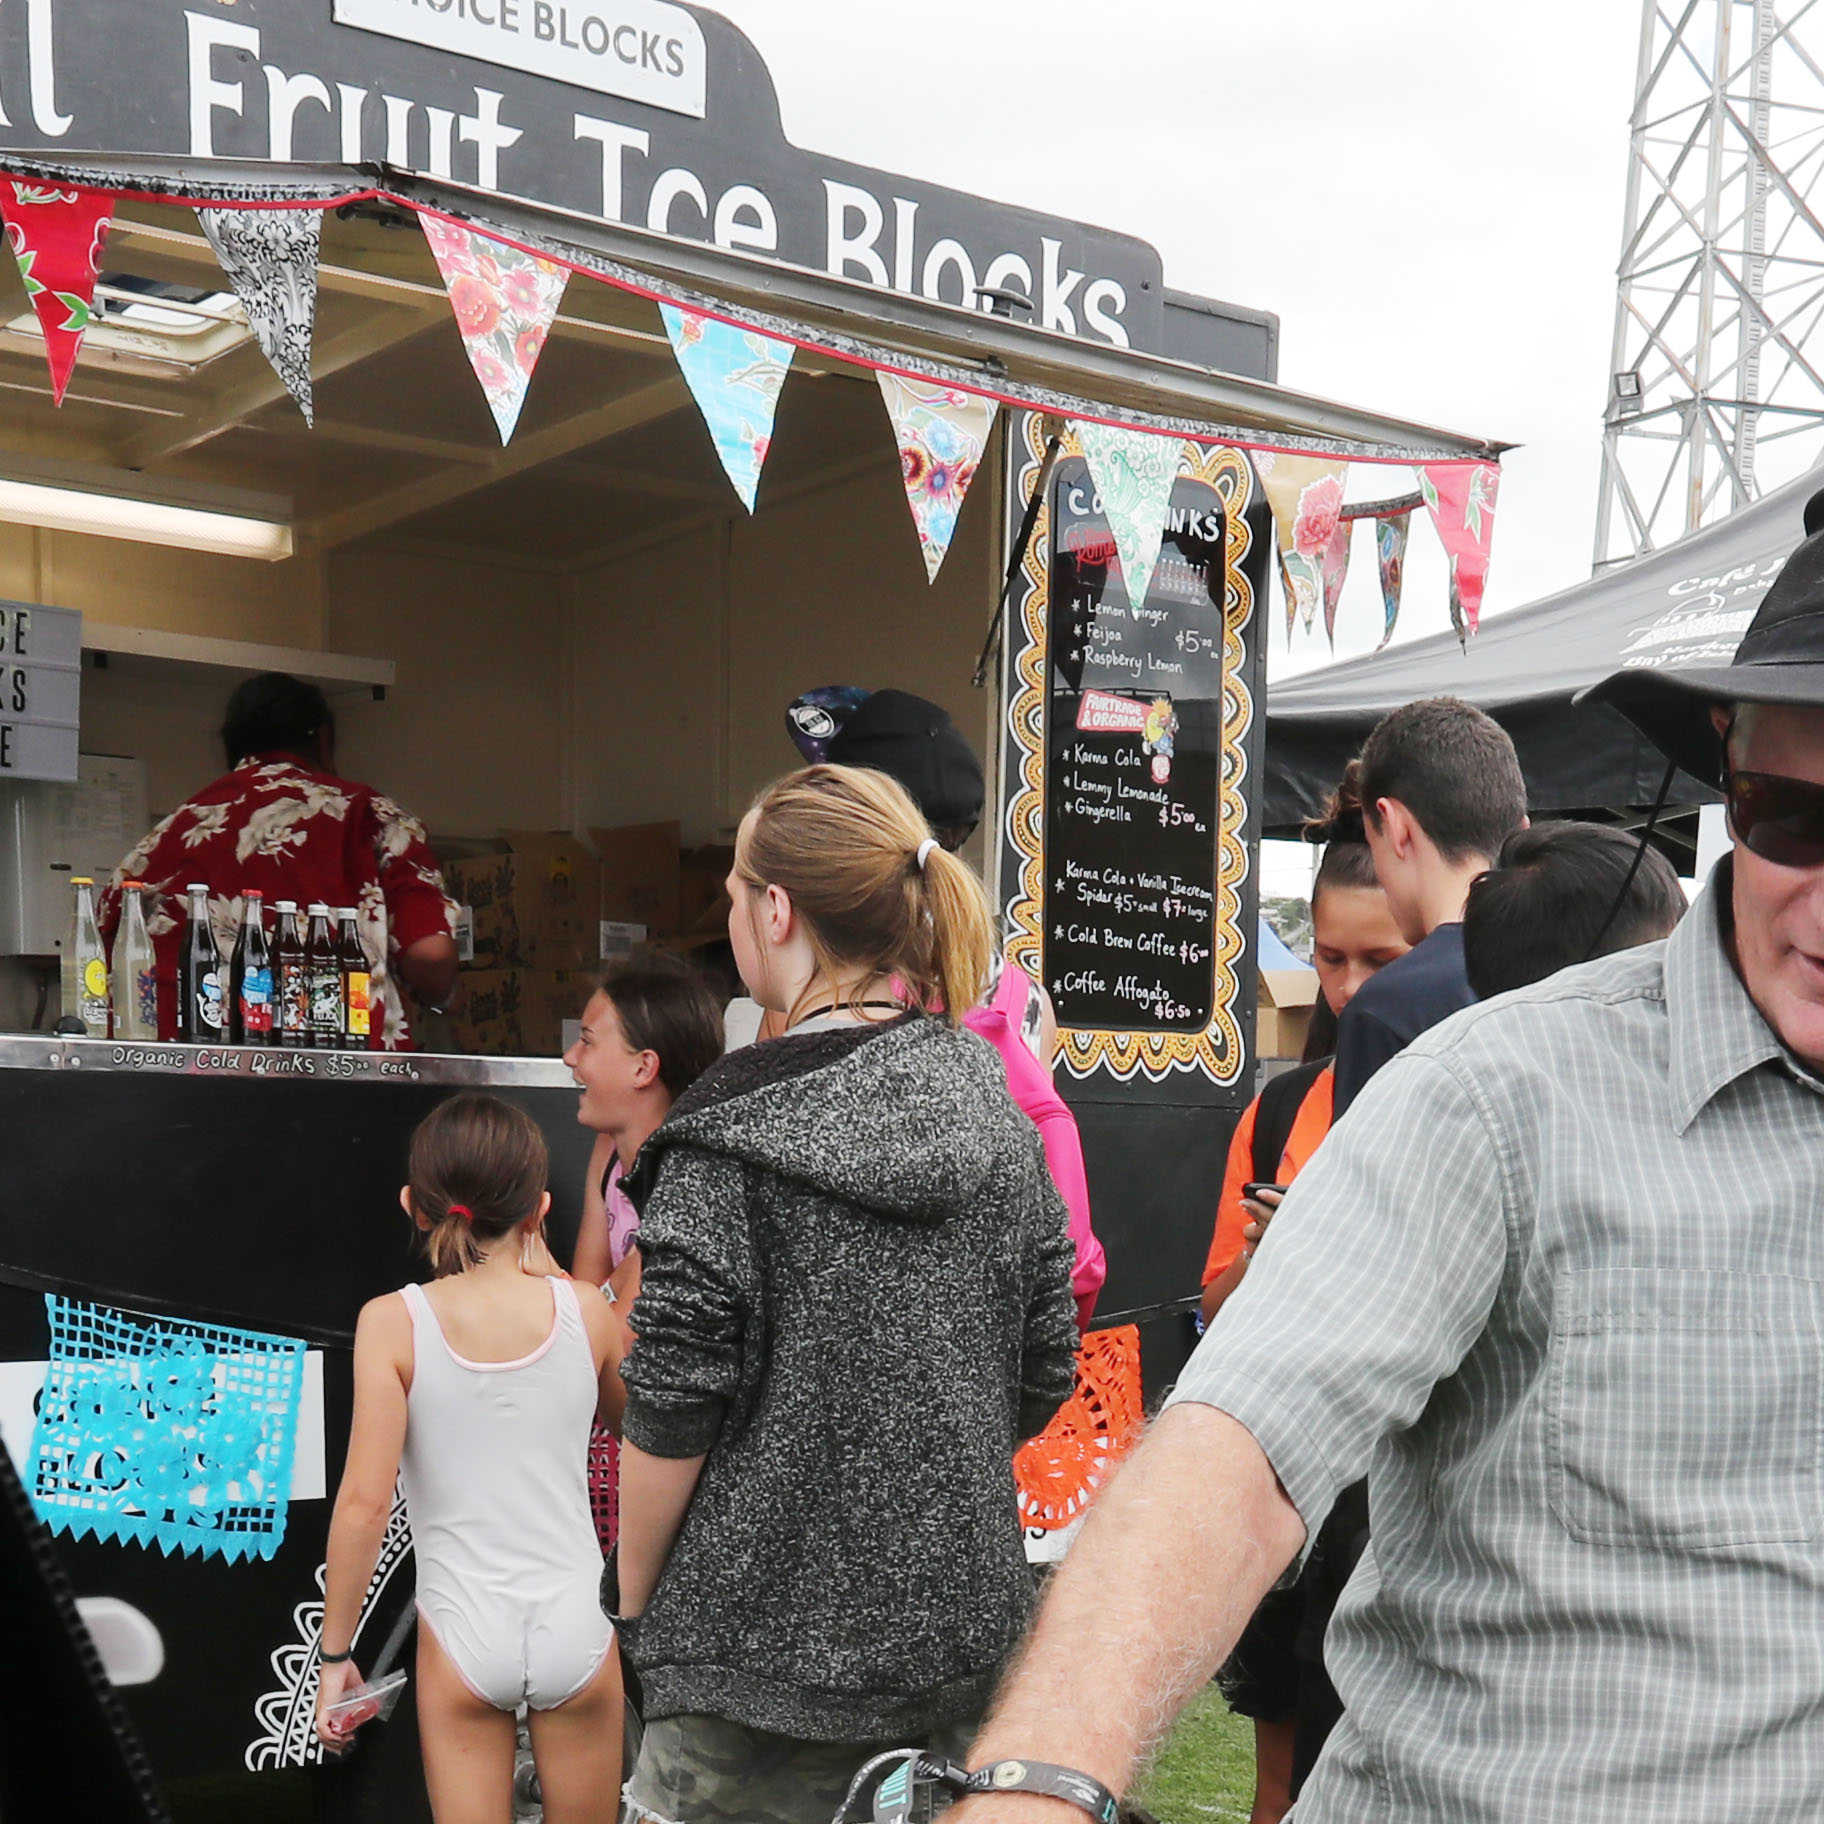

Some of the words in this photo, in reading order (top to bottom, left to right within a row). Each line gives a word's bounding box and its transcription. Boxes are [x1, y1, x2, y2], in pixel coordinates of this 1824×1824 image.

[534, 1, 684, 77] BLOCKS
[183, 10, 524, 191] Fruit
[574, 113, 777, 250] Ice
[821, 178, 1131, 348] Blocks
[1087, 594, 1126, 618] Lemon
[1086, 622, 1122, 646] Feijoa
[1083, 645, 1142, 678] Raspberry
[1148, 652, 1183, 674] Lemon
[1085, 693, 1142, 715] FAIRTRADE
[1093, 712, 1145, 727] ORGANIC
[1074, 743, 1108, 764] Karma
[1115, 748, 1141, 766] Cola
[1074, 771, 1113, 803] Lemmy
[1118, 777, 1169, 805] Lemonade
[1075, 797, 1132, 824] Gingerella
[1066, 859, 1099, 881] Karma
[1103, 868, 1126, 885] Cola
[1137, 872, 1167, 891] Vanilla
[1068, 924, 1098, 945] Cold
[1104, 928, 1133, 949] Brew
[1137, 933, 1176, 957] Coffee
[1064, 970, 1106, 994] Coffee
[1114, 976, 1169, 1010] Affogato
[1154, 1000, 1191, 1020] $6.50
[112, 1046, 184, 1068] Organic
[195, 1049, 240, 1071] Cold
